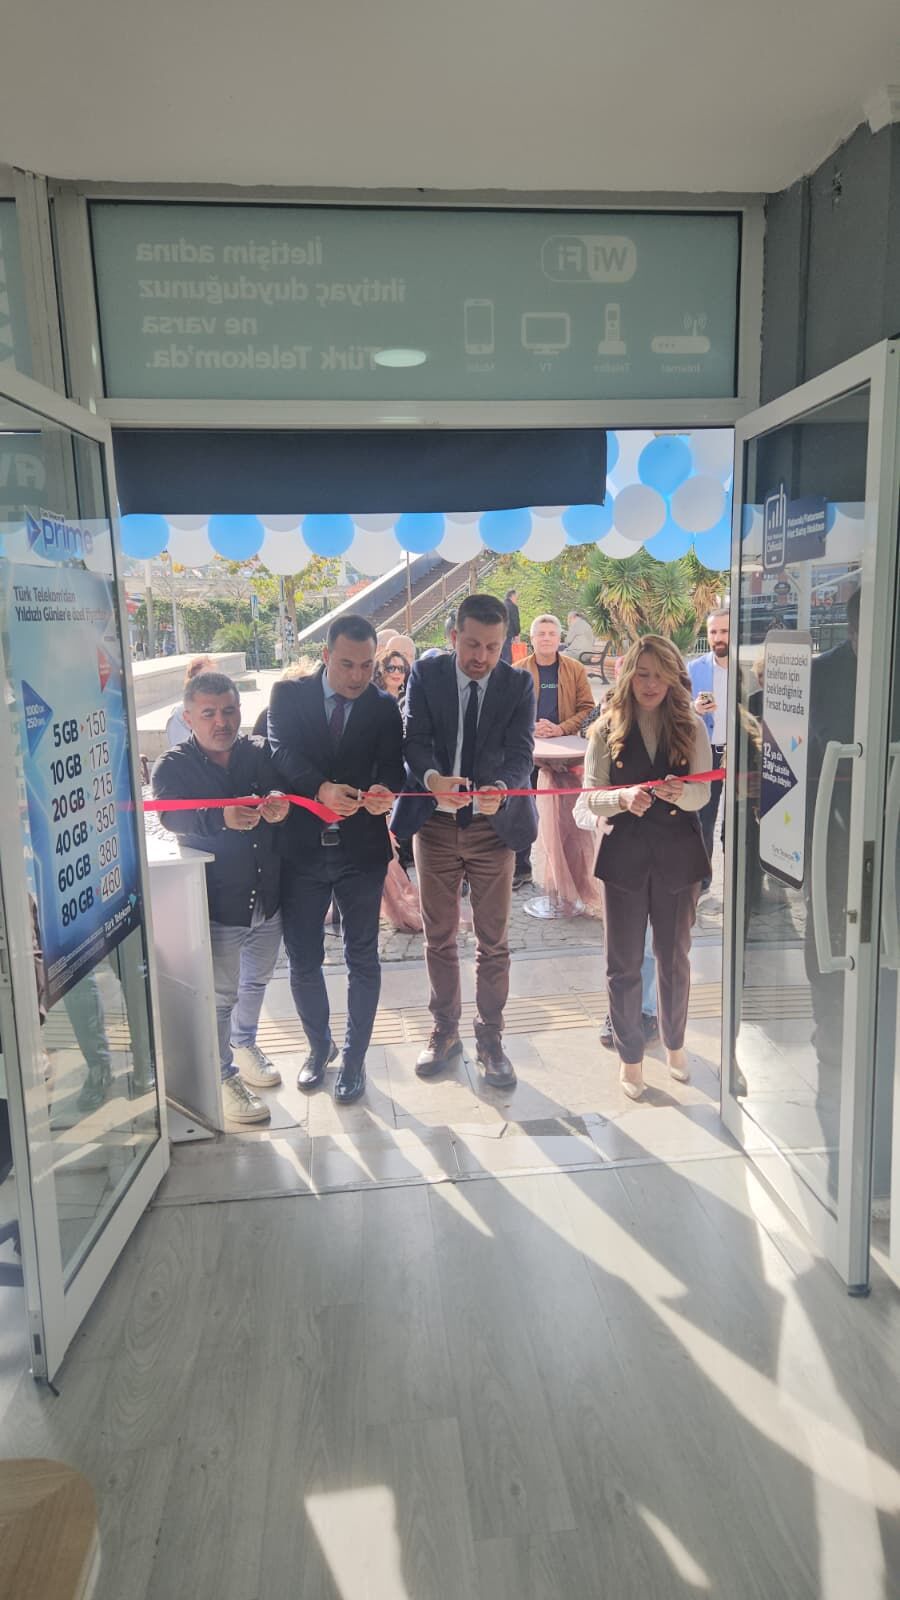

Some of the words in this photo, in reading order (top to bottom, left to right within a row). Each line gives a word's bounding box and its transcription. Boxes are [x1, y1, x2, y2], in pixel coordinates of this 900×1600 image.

[42, 518, 94, 553] prime
[13, 586, 32, 602] Türk
[15, 606, 42, 622] Yıldızlı
[782, 700, 805, 715] burada
[86, 710, 106, 738] 150
[89, 741, 110, 769] 175
[763, 742, 771, 758] 12
[93, 773, 113, 801] 215
[96, 803, 115, 833] 350
[99, 836, 118, 866] 380
[102, 867, 121, 897] 460
